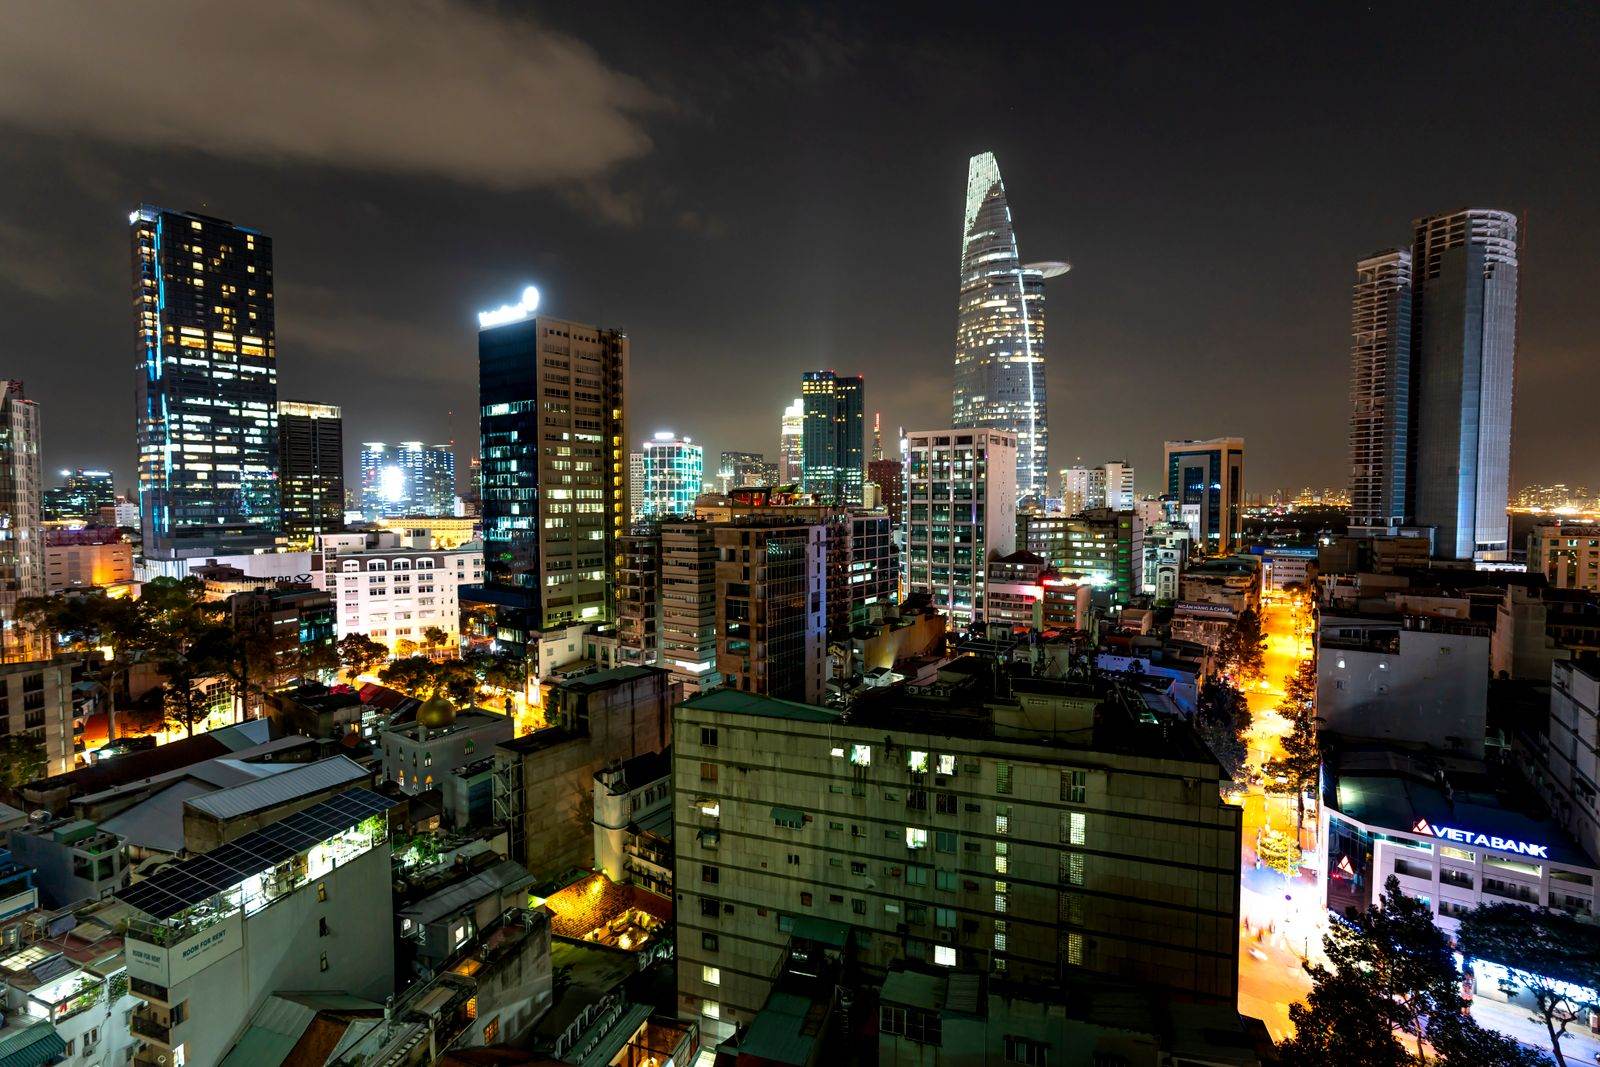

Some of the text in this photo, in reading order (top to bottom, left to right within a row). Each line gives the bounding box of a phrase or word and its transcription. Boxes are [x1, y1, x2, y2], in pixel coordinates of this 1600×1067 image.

[1432, 825, 1547, 858] VIETABANK
[182, 945, 199, 958] ROOM
[200, 937, 212, 947] FOR
[212, 930, 226, 942] RENT
